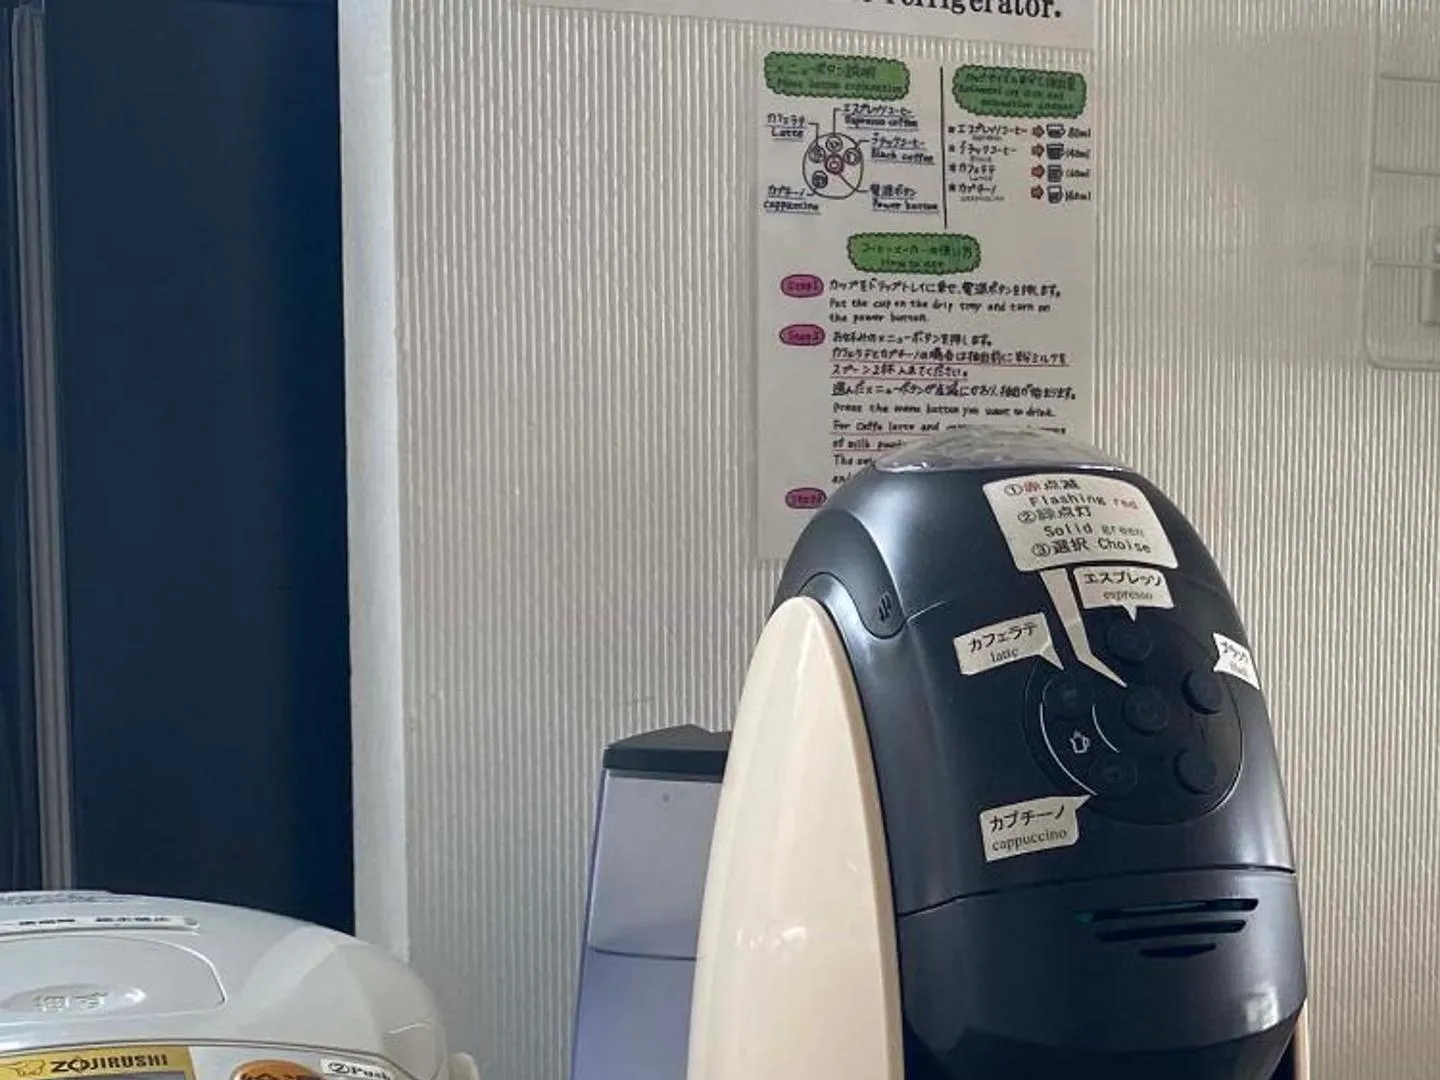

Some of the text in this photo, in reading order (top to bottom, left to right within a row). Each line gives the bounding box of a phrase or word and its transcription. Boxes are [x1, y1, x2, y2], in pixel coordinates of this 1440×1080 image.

[1029, 495, 1139, 510] Flashing red
[1043, 523, 1145, 538] Solid green
[1097, 537, 1152, 554] Choise
[1084, 569, 1163, 588] エスプレッソ
[1102, 589, 1154, 602] espresso
[968, 621, 1039, 654] カフェラテ
[989, 646, 1020, 665] latte
[988, 805, 1067, 833] カプチーノ
[991, 827, 1069, 853] cappuccino
[51, 1053, 169, 1075] ZOJIRUSHI
